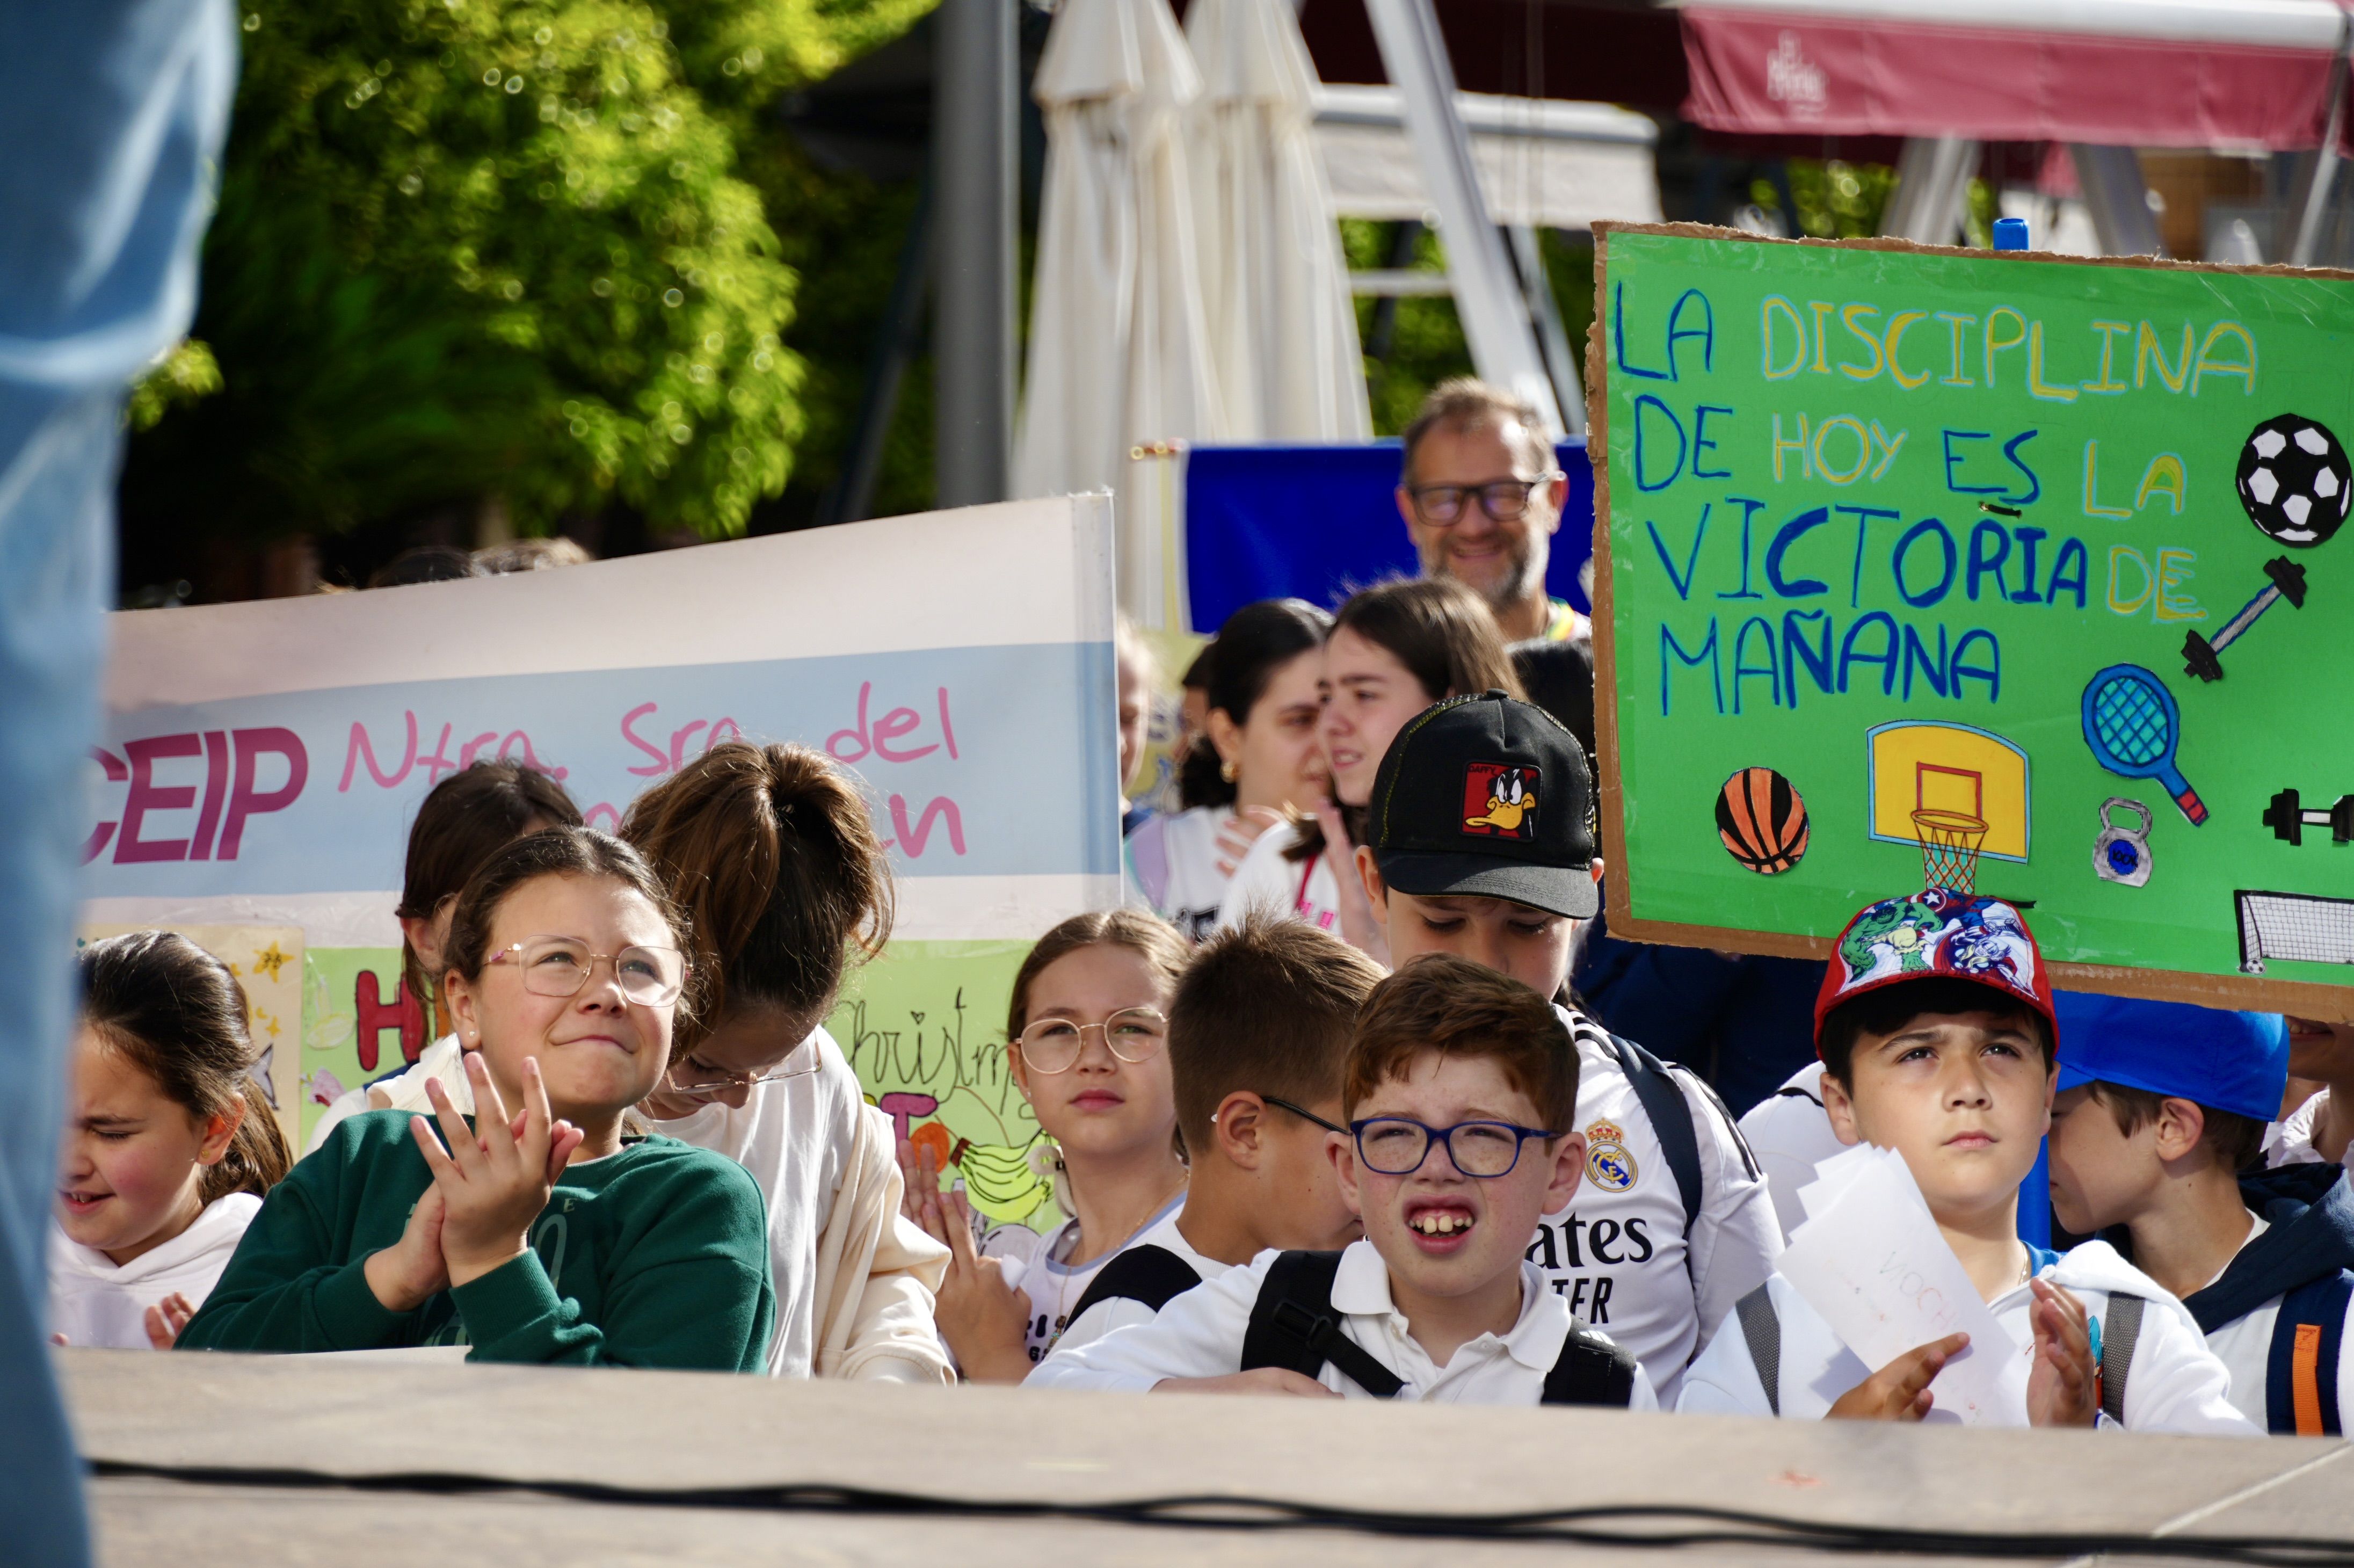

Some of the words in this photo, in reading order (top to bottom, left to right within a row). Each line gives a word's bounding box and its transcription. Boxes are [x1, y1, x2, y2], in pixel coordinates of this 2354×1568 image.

[1616, 280, 1714, 381] LA
[1760, 294, 2256, 401] DISCIPLINA
[1633, 394, 1733, 492] DE
[1772, 412, 1908, 484] HOY
[1943, 429, 2040, 504] ES
[2082, 440, 2185, 518] LA
[1645, 496, 2089, 608] VICTORIA
[2105, 545, 2208, 622] DE
[1659, 608, 2000, 716] MAÑANA
[826, 680, 958, 766] del
[1526, 1211, 1653, 1269] ates
